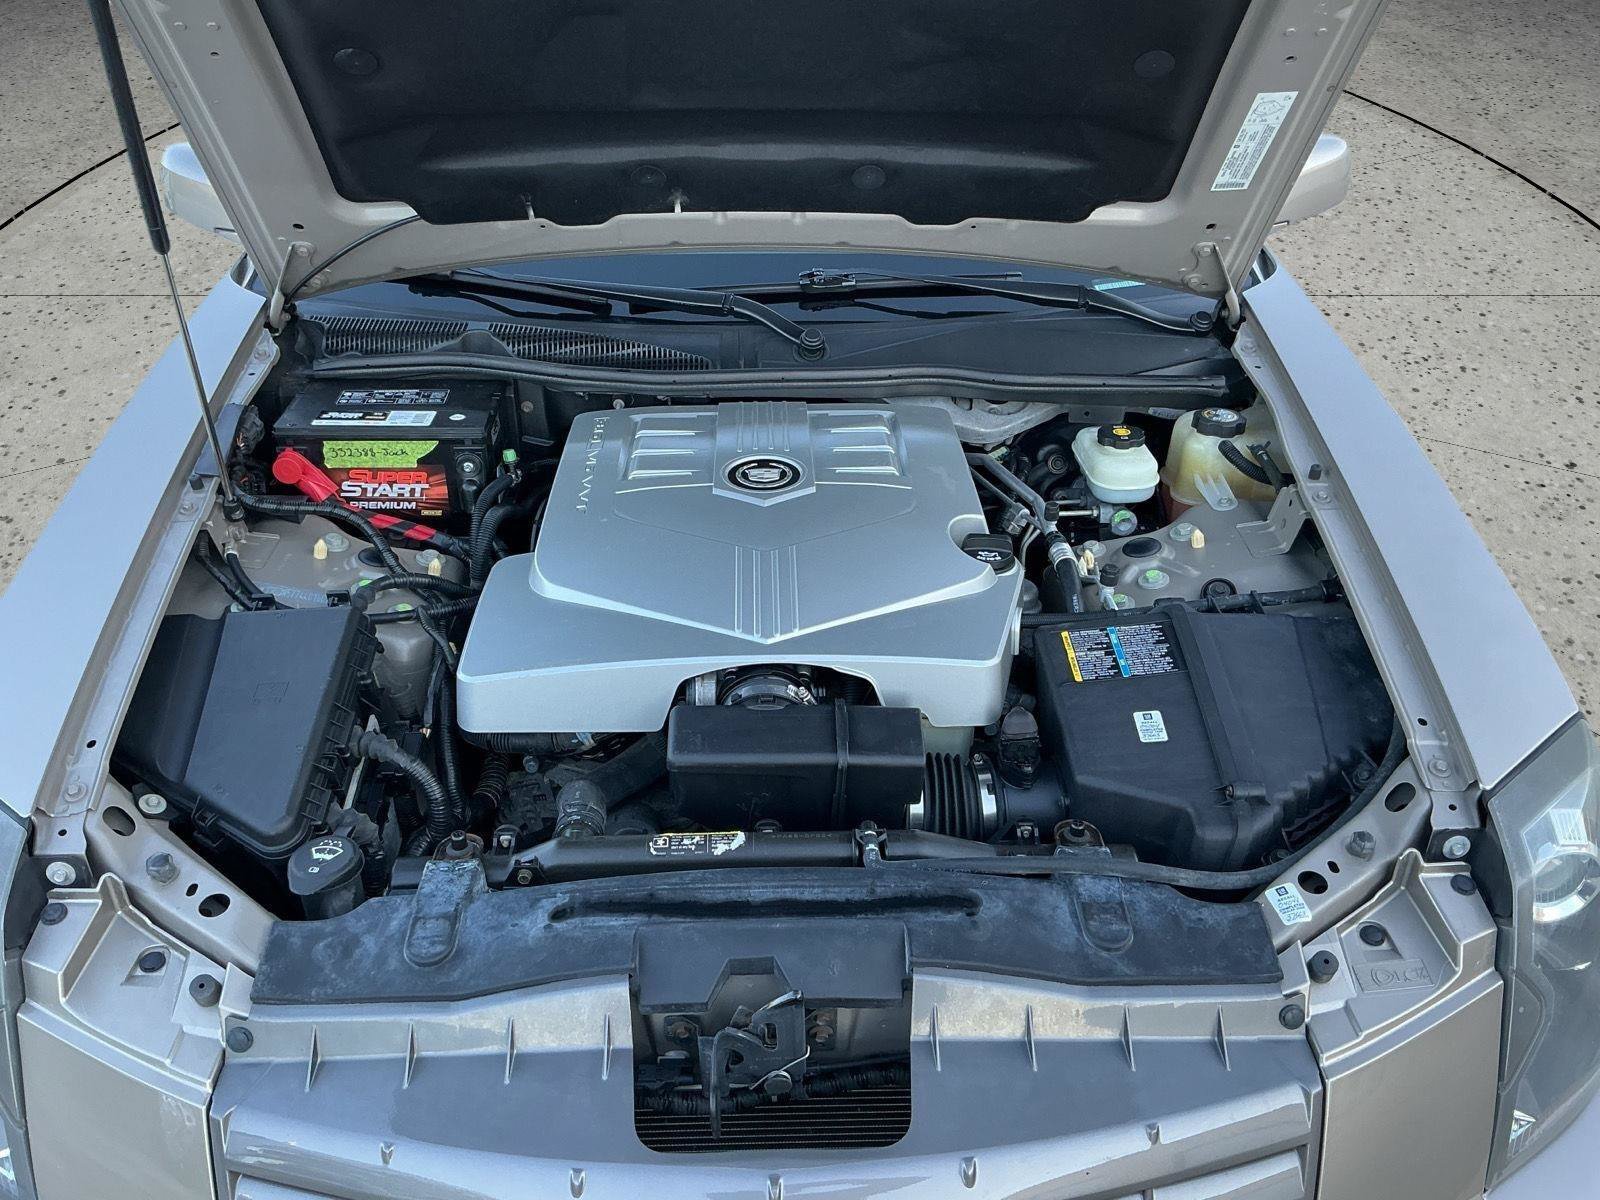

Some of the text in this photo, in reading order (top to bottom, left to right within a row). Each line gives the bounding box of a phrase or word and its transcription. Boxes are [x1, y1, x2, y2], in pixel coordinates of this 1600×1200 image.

[348, 469, 428, 485] SUPER
[340, 481, 430, 497] START
[350, 501, 417, 510] PREMIUM
